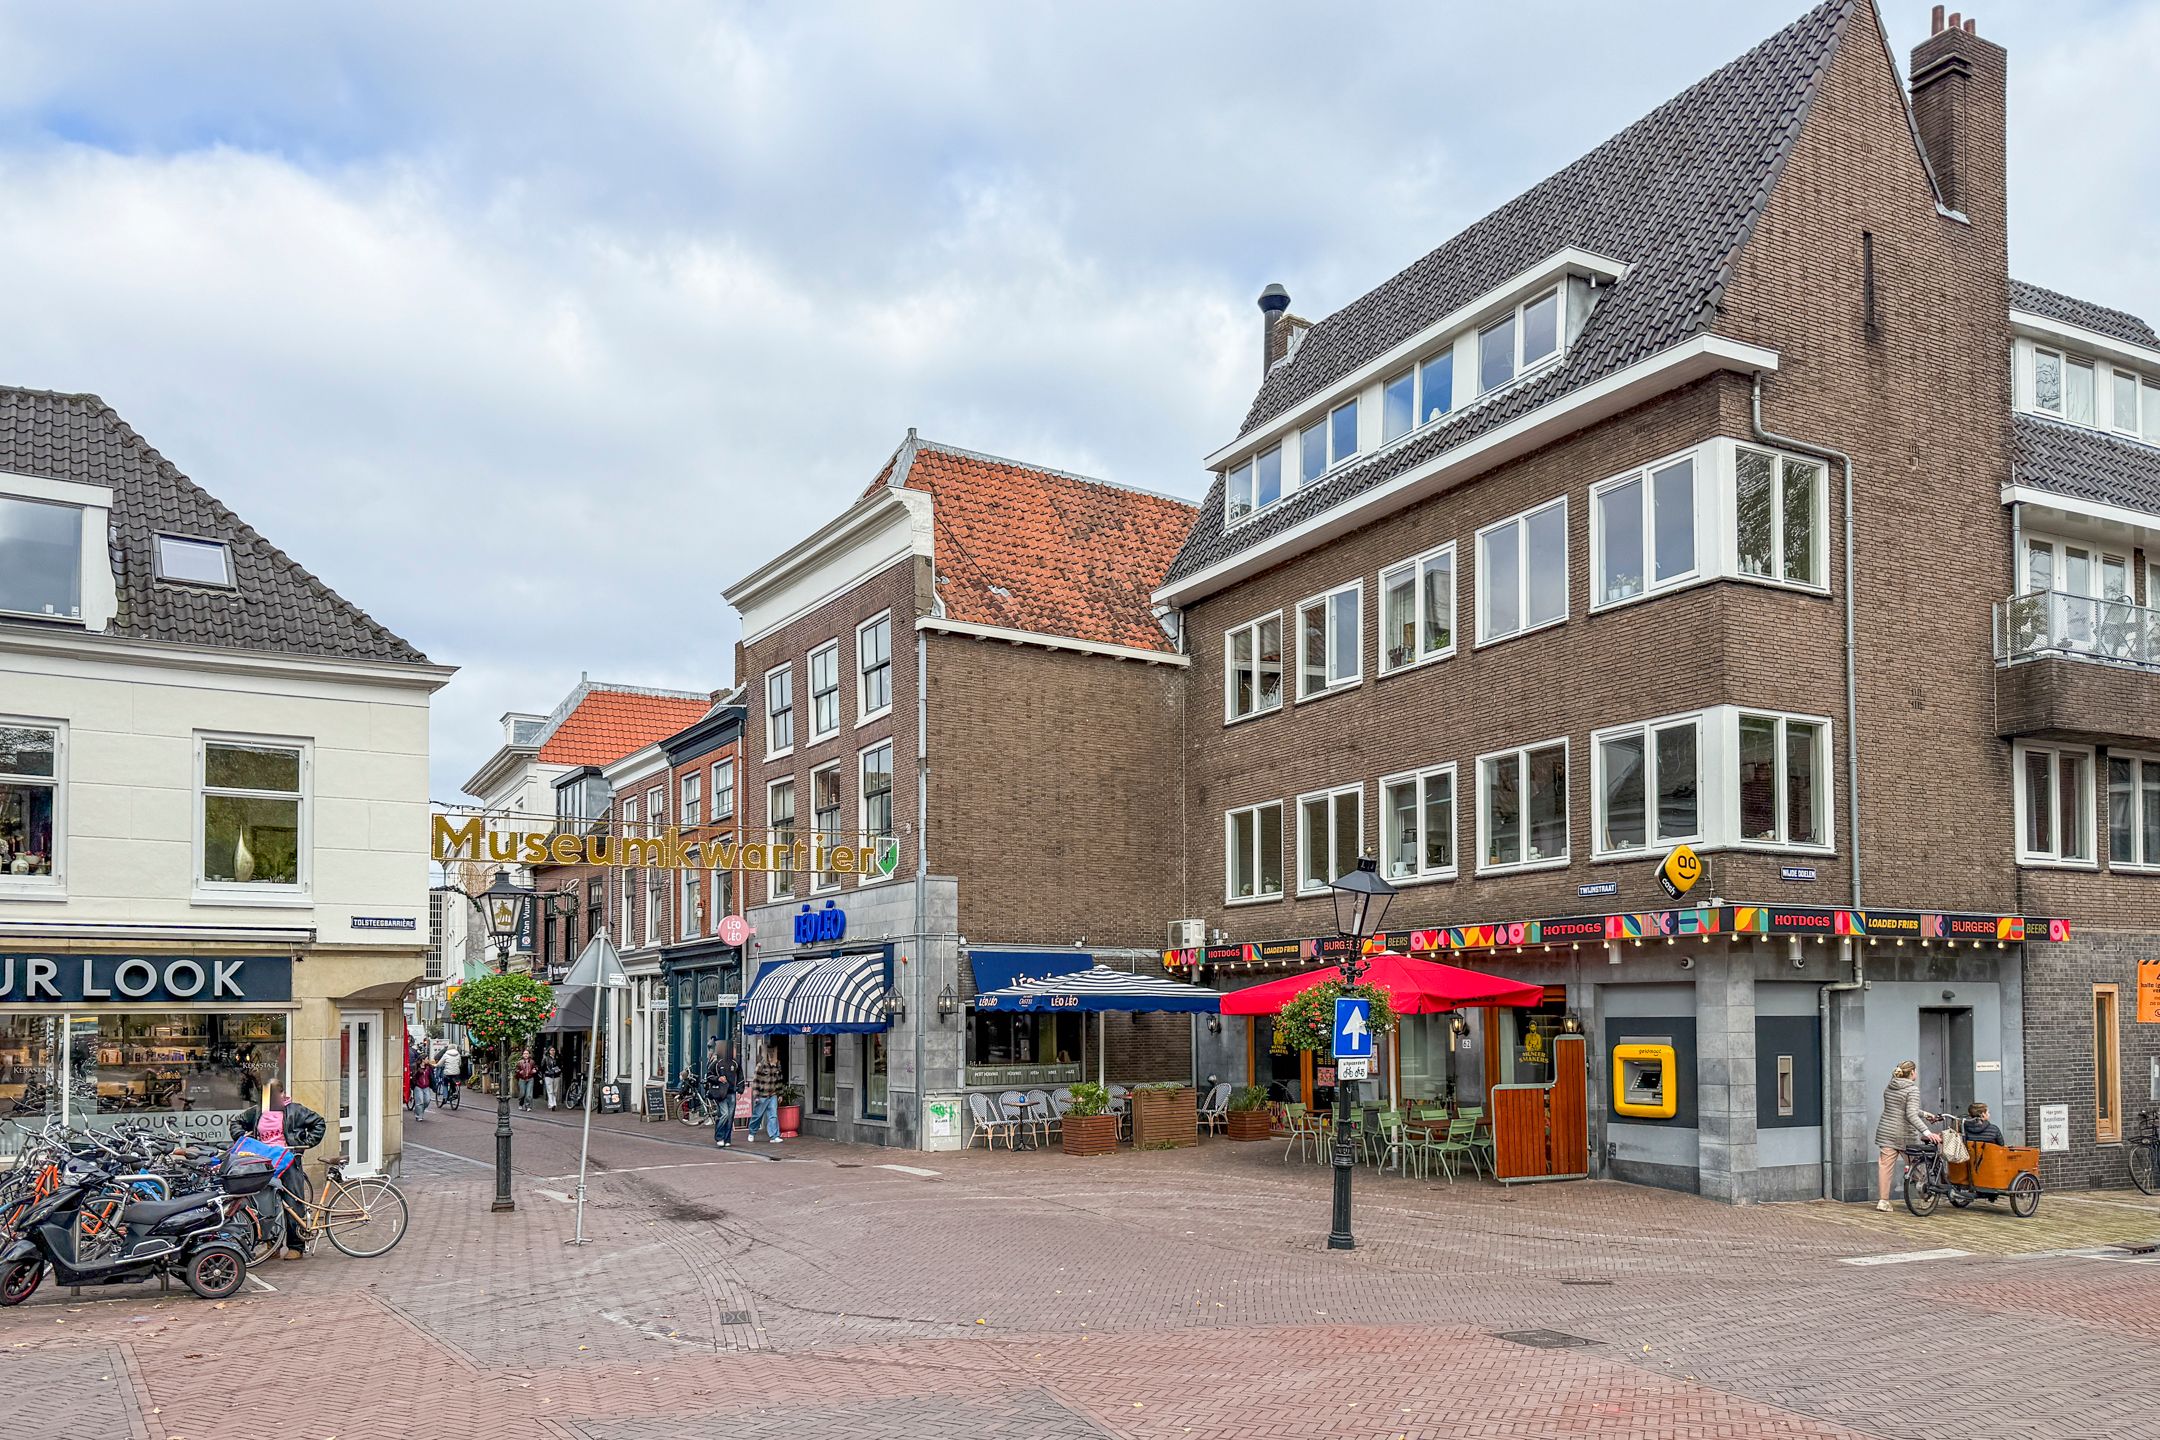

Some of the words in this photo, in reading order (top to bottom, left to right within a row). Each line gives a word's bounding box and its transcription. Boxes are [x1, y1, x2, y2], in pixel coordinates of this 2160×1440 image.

[433, 815, 876, 873] Museumkwartier
[1580, 885, 1614, 894] TWIJNSTRAAT
[1662, 878, 1676, 896] cash
[354, 918, 414, 927] TOLSTEEGBARRIÈRE
[727, 918, 741, 929] LÉO
[1774, 915, 1830, 926] HOTDOGS
[1868, 918, 1896, 928] LOADED
[1898, 919, 1918, 929] FRIES
[1543, 923, 1602, 935] HOTDOGS
[1952, 921, 1995, 933] BURGERS
[2026, 924, 2047, 934] BEERS
[727, 930, 741, 942] LÉO
[1387, 937, 1408, 946] BEERS
[1208, 949, 1240, 958] HOTDOGS
[83, 959, 245, 997] LOOK
[1051, 995, 1065, 1007] LÉO
[1065, 995, 1079, 1006] LÉO
[124, 1116, 178, 1129] YOUR
[185, 1114, 235, 1128] LOOK
